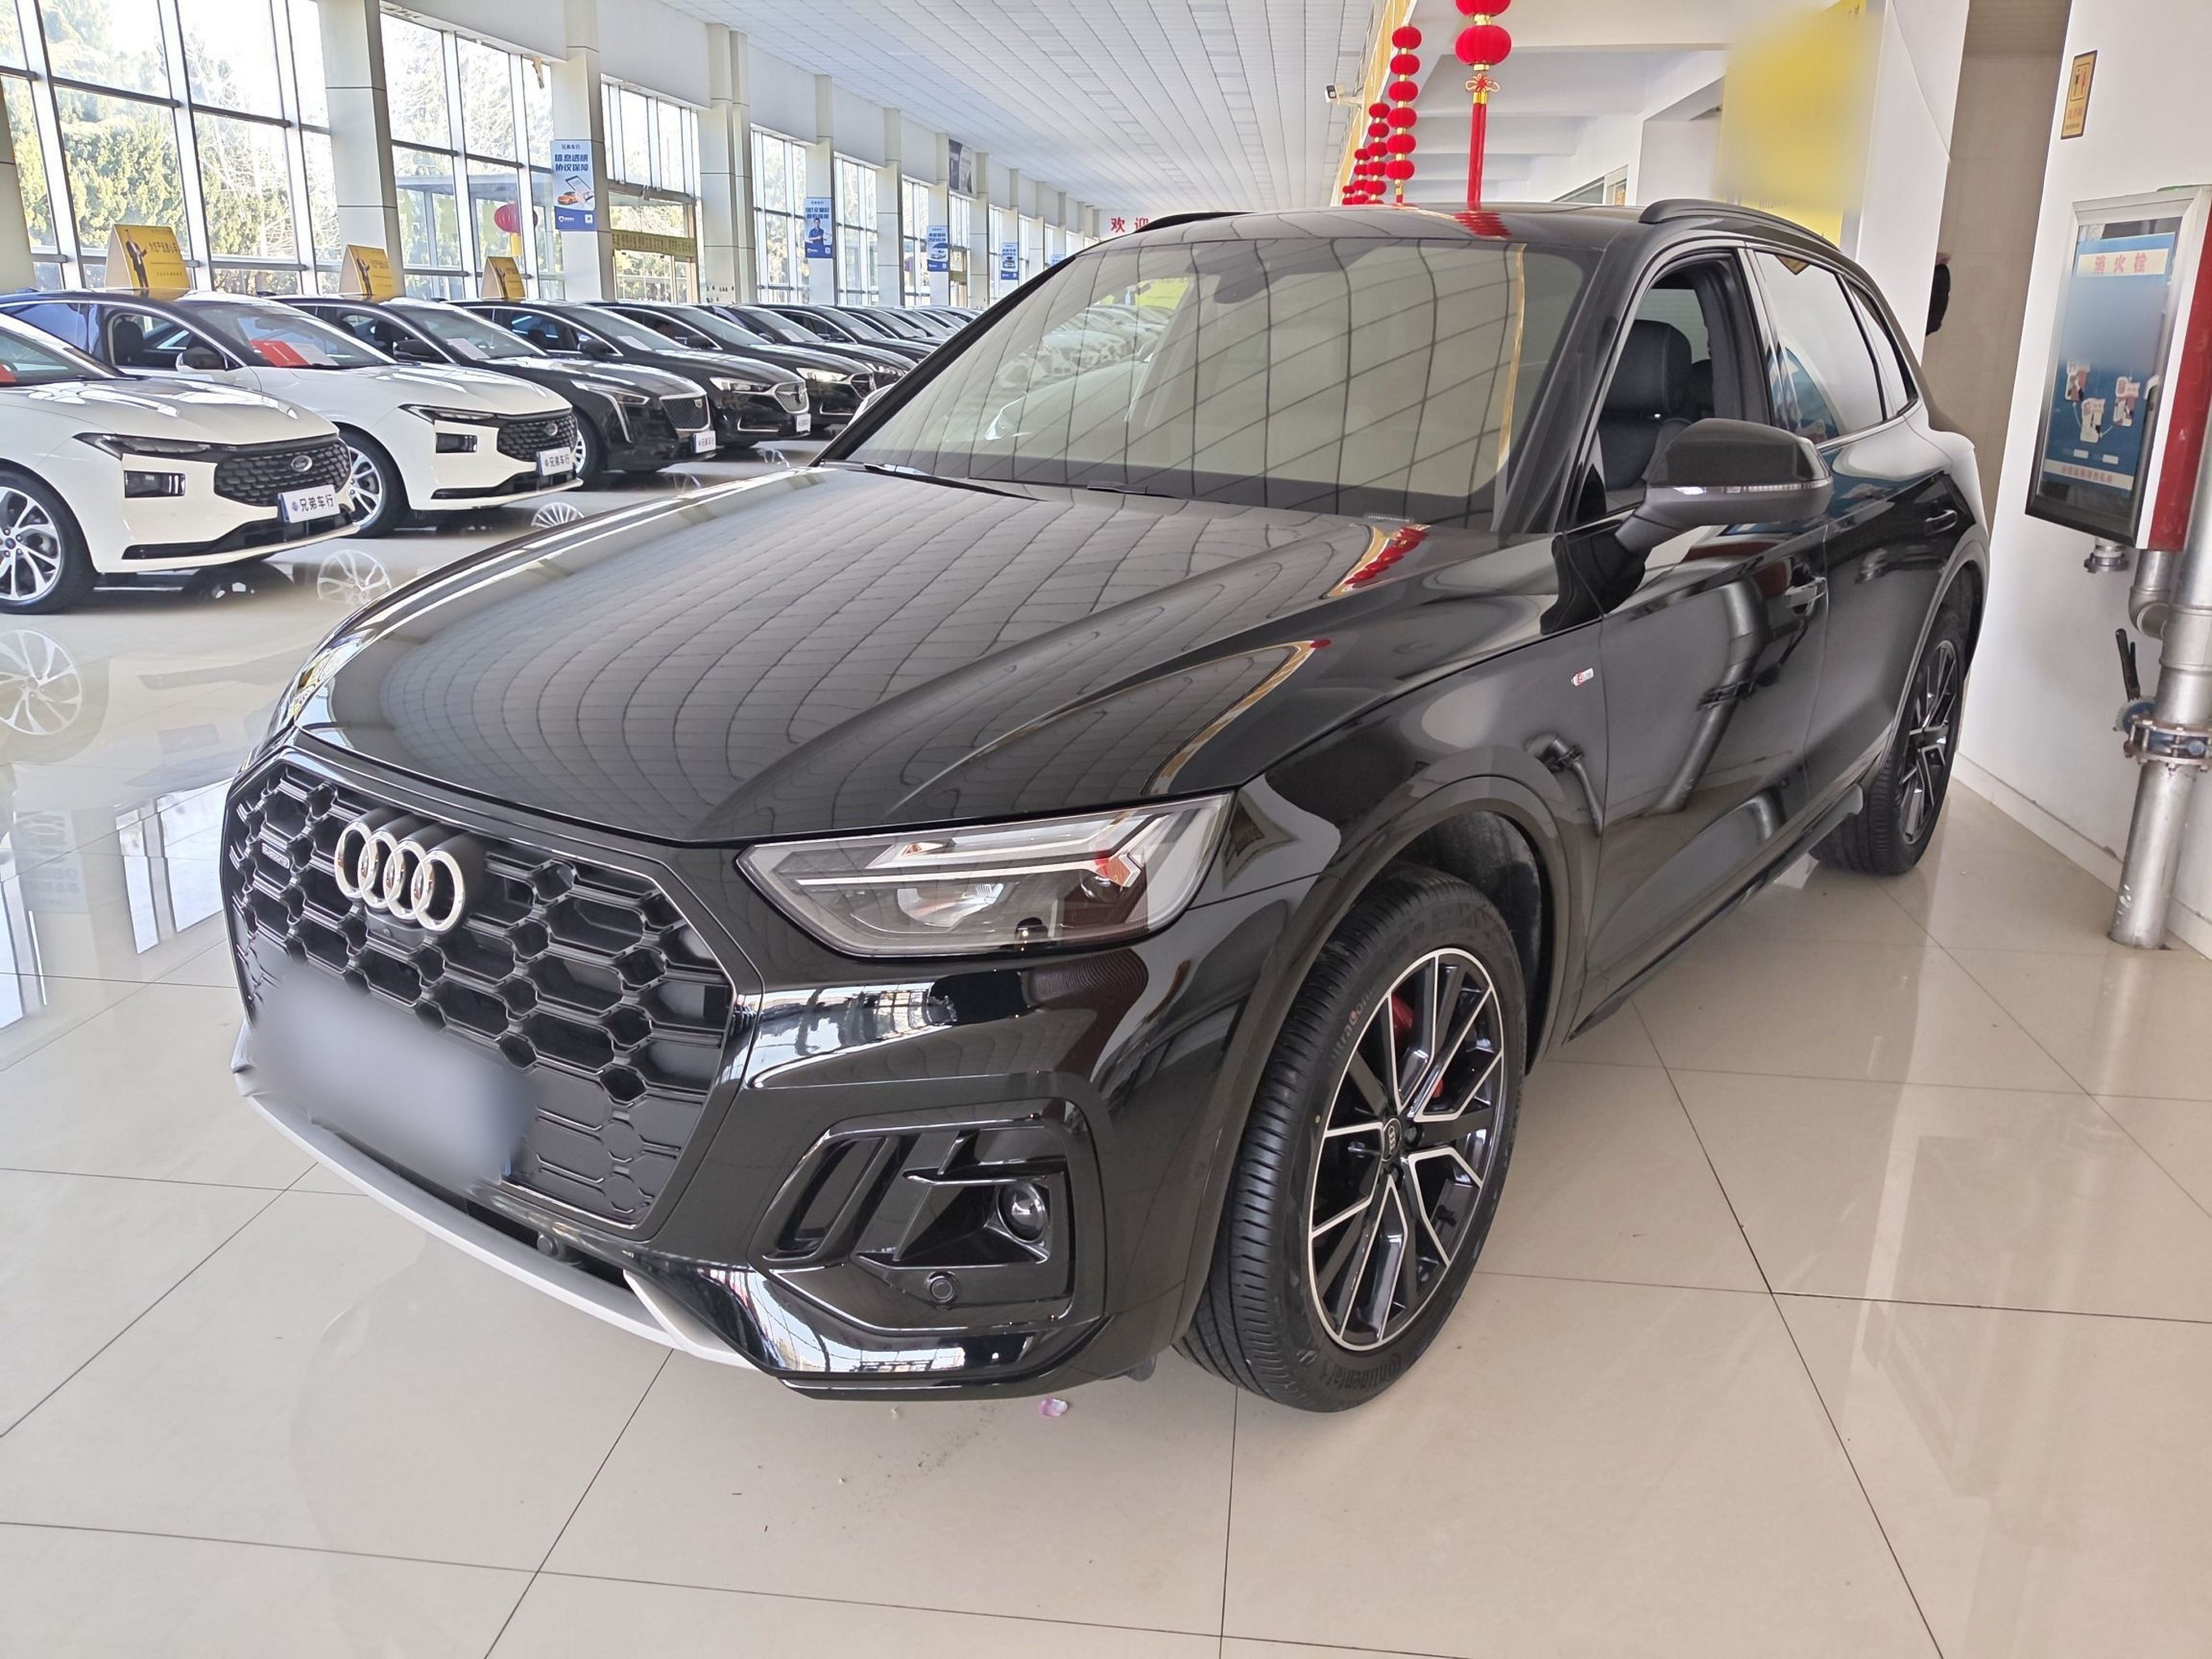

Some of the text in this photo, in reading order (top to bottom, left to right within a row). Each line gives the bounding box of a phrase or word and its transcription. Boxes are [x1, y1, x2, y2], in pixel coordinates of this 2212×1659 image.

[555, 154, 588, 162] 信息透明
[2093, 252, 2147, 274] 消火栓
[299, 494, 334, 512] 兄弟车行
